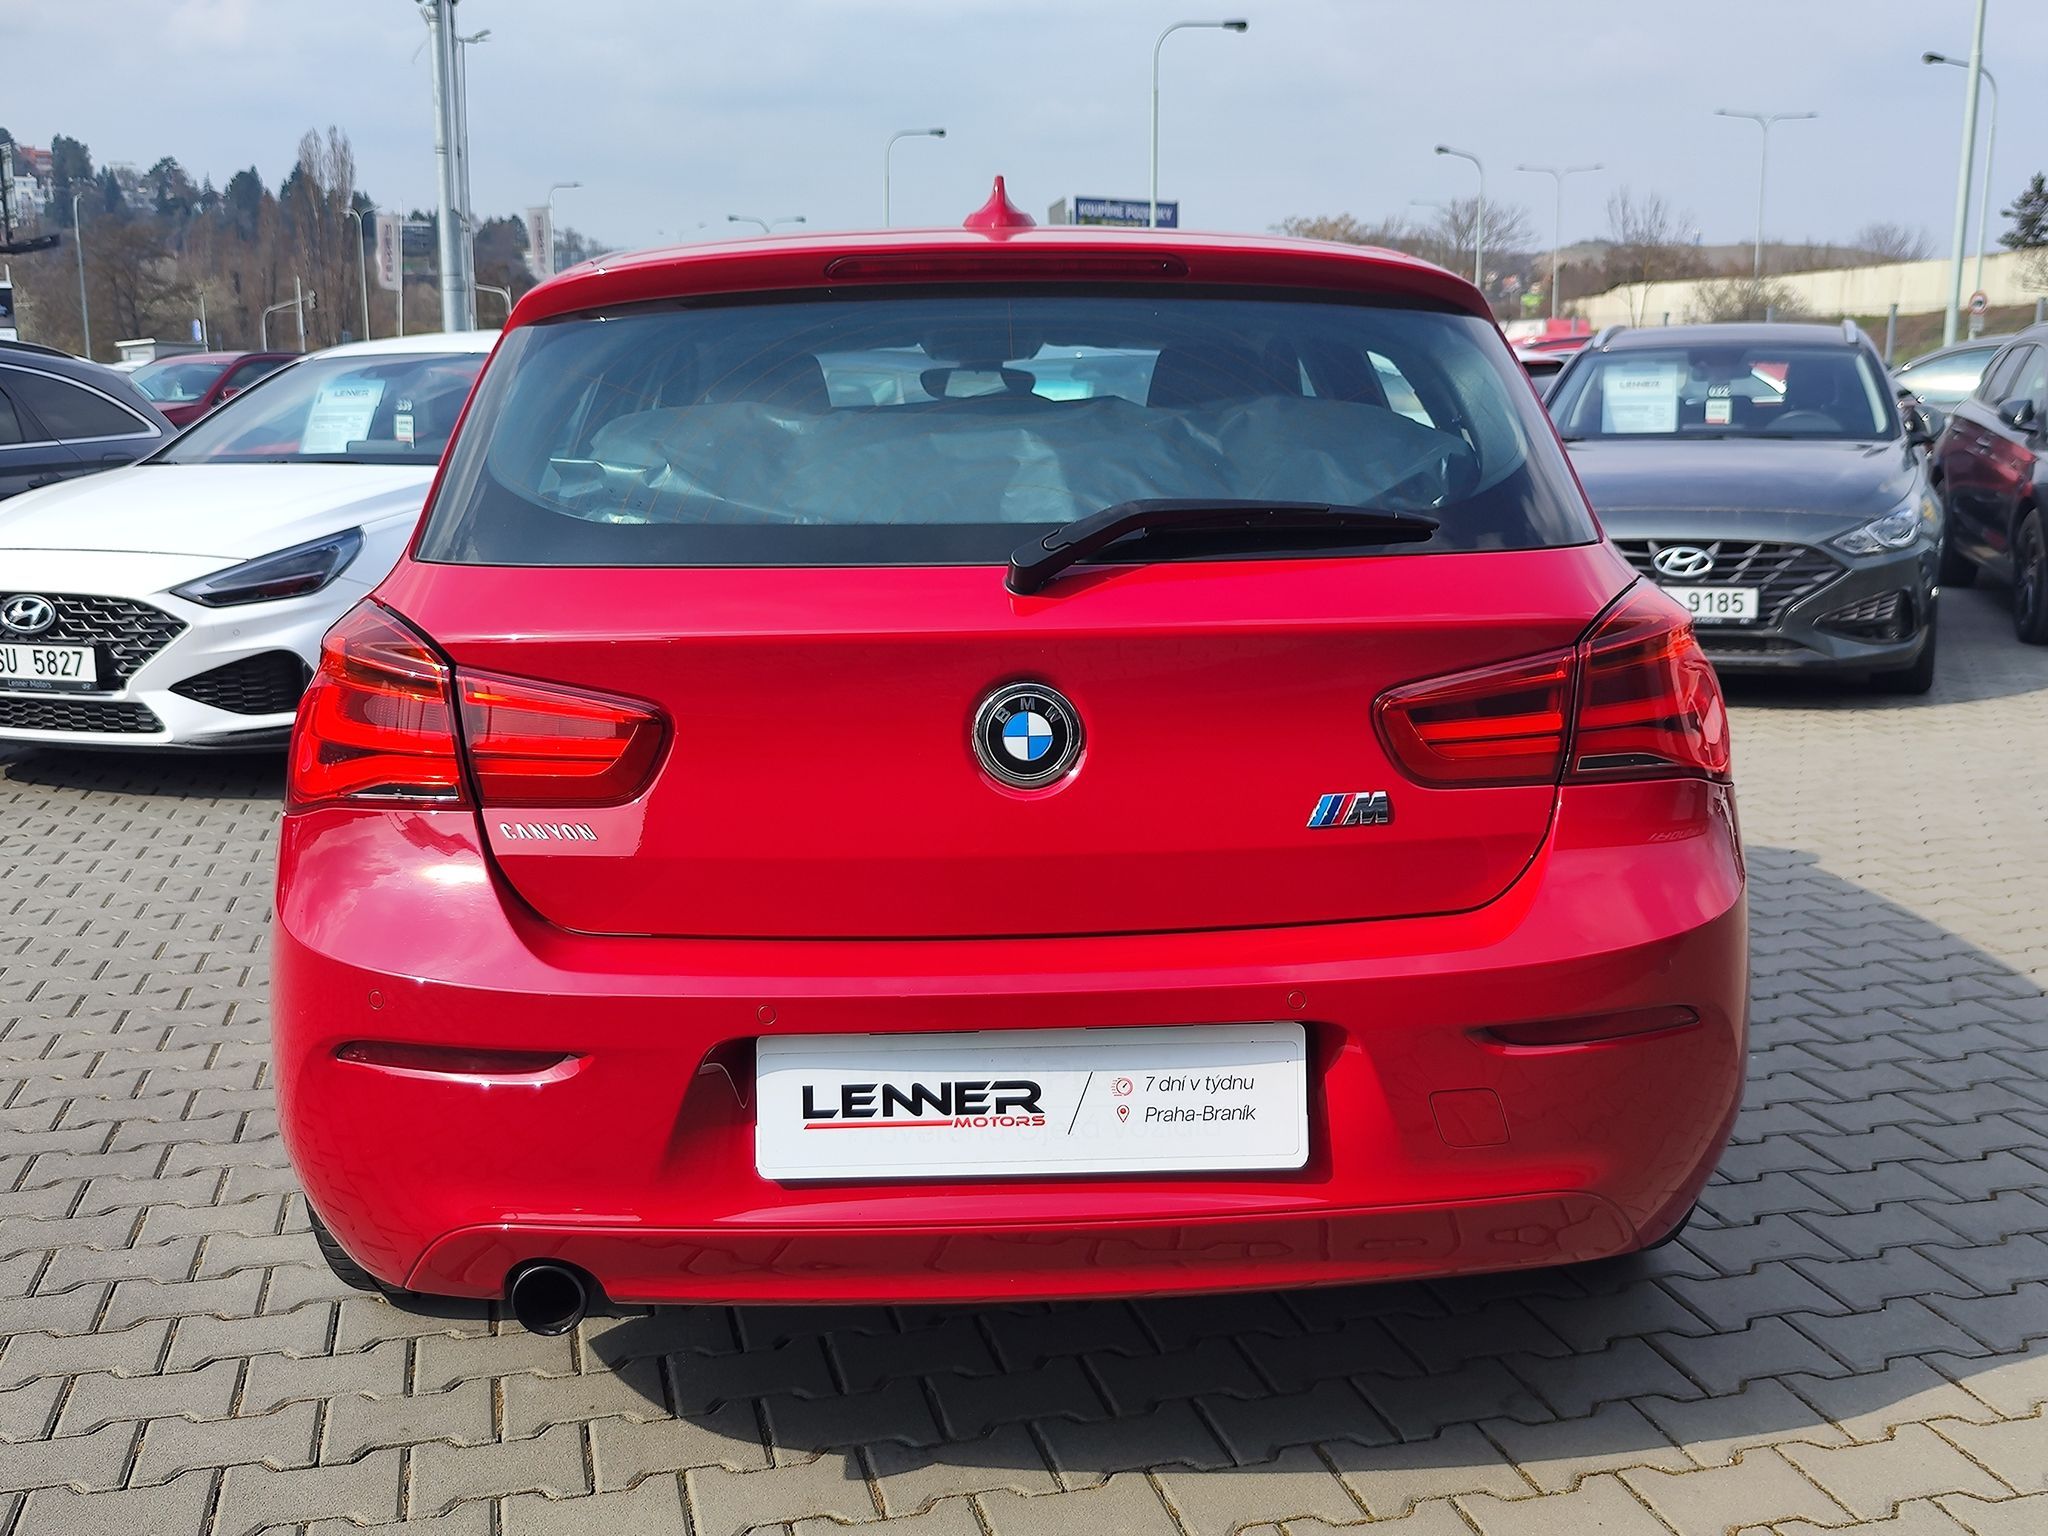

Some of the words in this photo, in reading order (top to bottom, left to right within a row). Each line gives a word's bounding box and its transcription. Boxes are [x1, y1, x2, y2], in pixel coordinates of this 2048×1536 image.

[1688, 592, 1744, 613] 9185
[33, 649, 83, 677] 5827
[29, 680, 52, 689] Motors
[994, 697, 1062, 724] BMW
[499, 822, 598, 841] CANYON
[1145, 1075, 1156, 1092] 7
[1158, 1075, 1187, 1092] dní
[1190, 1077, 1201, 1091] v
[1205, 1074, 1255, 1095] týdnu
[802, 1080, 1046, 1120] LENNER
[953, 1114, 1046, 1129] MOTORS
[1144, 1104, 1257, 1123] Praha-Braník
